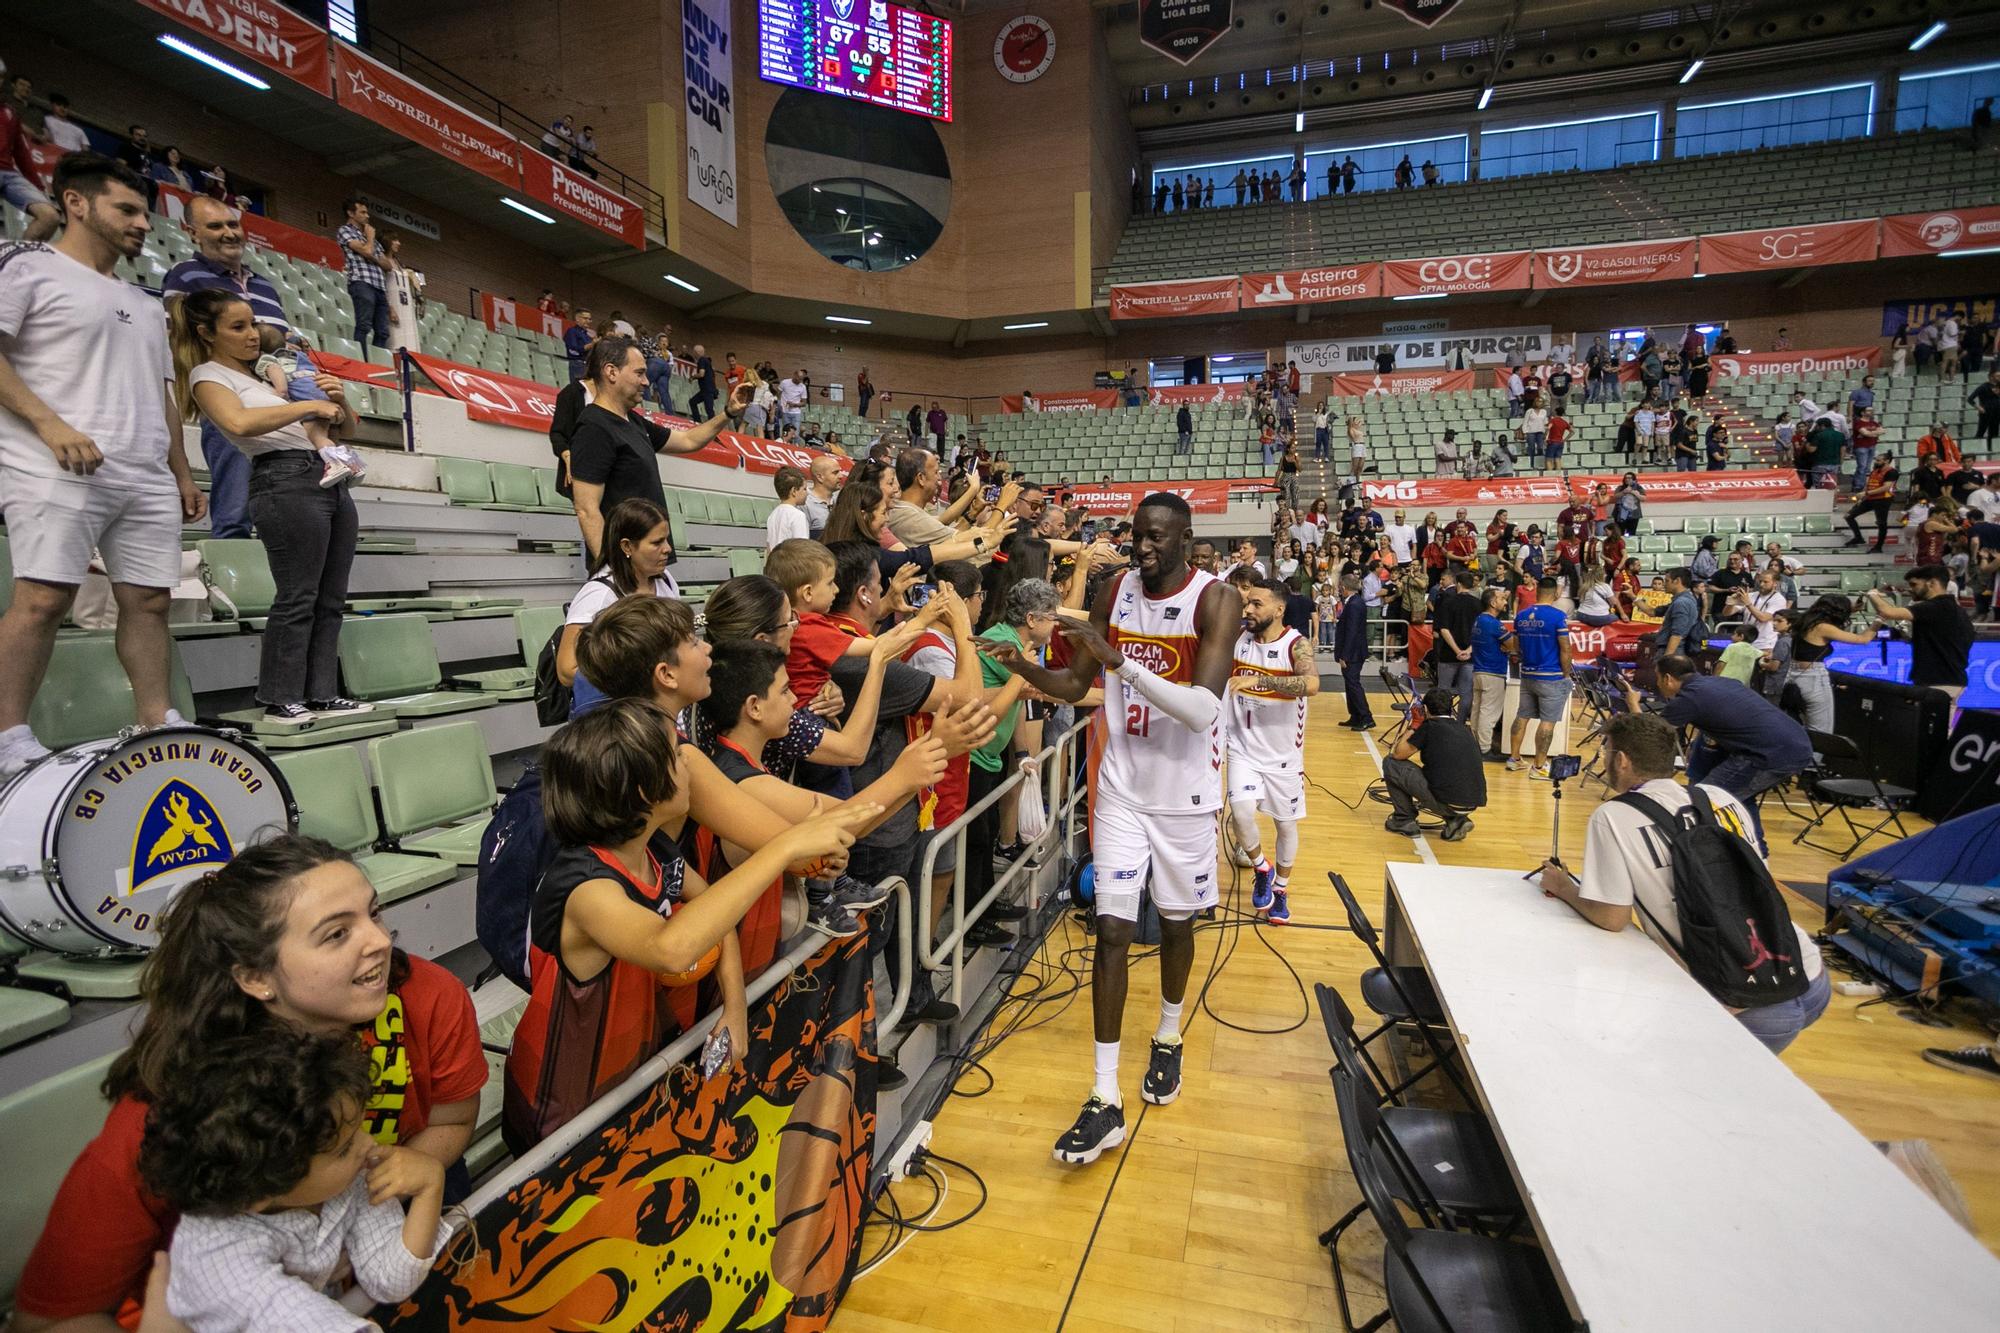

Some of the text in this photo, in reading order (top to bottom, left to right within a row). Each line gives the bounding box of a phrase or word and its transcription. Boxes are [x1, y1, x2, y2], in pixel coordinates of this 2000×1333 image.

[1162, 4, 1210, 19] LIGA BSR
[684, 0, 728, 54] MUY
[829, 25, 854, 45] 67
[685, 24, 709, 67] DE
[867, 35, 891, 55] 55
[849, 50, 873, 66] 0.0
[686, 53, 730, 113] MUR
[687, 86, 723, 133] CIA
[376, 88, 451, 137] ESTRELLA
[461, 133, 514, 168] LEVANTE
[552, 164, 624, 221] Prevemur
[553, 192, 624, 235] Prevención y Salud
[404, 214, 438, 235] Oeste
[1585, 253, 1681, 269] V2 GASOLINERAS
[1300, 269, 1357, 285] Asterra
[1300, 282, 1366, 300] Partners
[1419, 281, 1491, 294] OFTALMOLOGÍA
[1132, 295, 1181, 306] ESTRELLA
[1188, 290, 1233, 302] LEVANTE
[1406, 342, 1435, 359] DE
[1748, 357, 1869, 376] superDumbo
[1392, 377, 1442, 388] MITSUBISHI
[1609, 479, 1694, 491] ERELLA
[1707, 479, 1790, 489] LEVANTE
[1121, 643, 1163, 660] UCAM
[1135, 659, 1169, 674] RCIA
[1126, 704, 1149, 738] 21
[73, 742, 264, 821] UCAM MURCIA CB
[160, 846, 209, 866] UCAM
[1120, 869, 1138, 880] ESP
[1746, 966, 1797, 985] AIR
